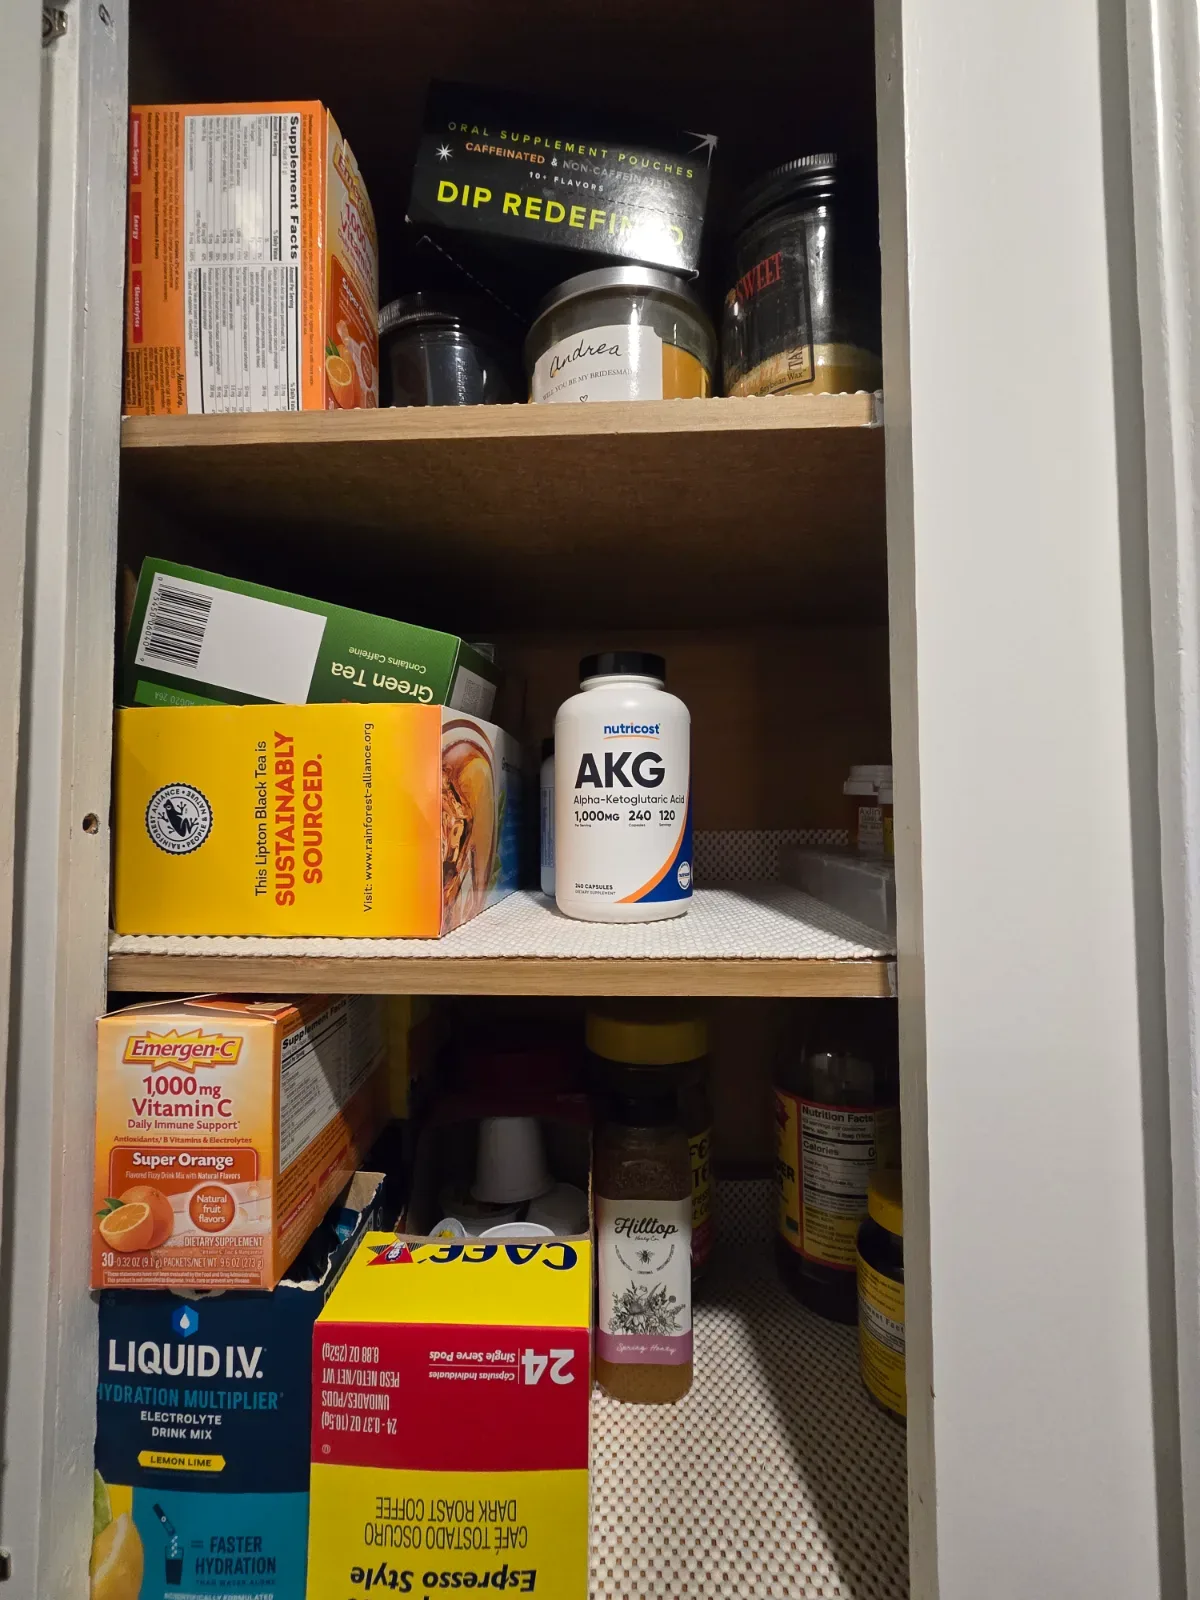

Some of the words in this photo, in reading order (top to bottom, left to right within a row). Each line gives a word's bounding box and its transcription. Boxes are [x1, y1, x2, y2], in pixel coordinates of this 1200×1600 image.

[448, 121, 489, 137] ORAL
[500, 130, 608, 159] SUPPLEMENT
[618, 153, 694, 179] POUCHES
[132, 148, 140, 177] Support
[288, 115, 299, 209] Supplement
[465, 142, 546, 164] CAFFEINATED
[551, 157, 558, 167] &
[563, 160, 672, 190] NON-CAFFEINATED
[529, 171, 547, 181] 10+
[553, 175, 604, 192] FLAVORS
[437, 180, 492, 209] DIP
[502, 192, 684, 246] REDEFIND
[132, 214, 140, 239] Energy
[289, 216, 299, 260] Facts
[735, 251, 782, 304] SWEET
[555, 381, 567, 392] YOU
[568, 377, 577, 386] BE
[578, 373, 589, 383] MY
[149, 591, 161, 617] 75450
[143, 620, 154, 647] 06040
[348, 646, 386, 663] Caffeine
[331, 662, 367, 687] Tea
[388, 657, 427, 674] Contains
[372, 673, 434, 703] Green
[603, 722, 659, 735] nutricost
[255, 741, 267, 752] is
[255, 755, 267, 778] Tea
[574, 751, 665, 789] AKG
[152, 789, 180, 813] ALLIANCE
[186, 791, 207, 814] NATURE
[255, 781, 267, 819] Black
[363, 723, 375, 880] www.rainforest-alliance.org
[573, 794, 668, 806] Alpha-Ketoglutaric
[669, 795, 685, 804] Acid
[274, 731, 295, 906] SUSTAINABLY
[303, 753, 323, 884] SOURCED.
[628, 810, 652, 821] 240
[659, 810, 676, 821] 120
[150, 816, 180, 849] RAINFOREST
[186, 824, 207, 847] PEOPLE
[255, 823, 271, 865] Lipton
[255, 868, 267, 896] This
[363, 884, 372, 913] Visit:
[282, 1012, 329, 1050] Supplement
[131, 1040, 236, 1062] Emergen-C
[142, 1075, 197, 1098] 1,000
[199, 1084, 222, 1099] mg
[132, 1097, 214, 1118] Vitamin
[217, 1098, 233, 1118] C
[802, 1105, 844, 1122] Nutrition
[847, 1113, 873, 1123] Facts
[127, 1119, 152, 1132] Daily
[154, 1120, 195, 1130] Immune
[170, 1136, 201, 1144] Vitamins
[202, 1136, 209, 1144] &
[209, 1137, 252, 1145] Electrolytes
[803, 1141, 839, 1156] Calories
[132, 1152, 176, 1167] Super
[178, 1153, 234, 1170] Orange
[125, 1171, 147, 1179] Flavored
[148, 1171, 161, 1180] Fizzy
[185, 1172, 197, 1180] with
[197, 1172, 219, 1180] Natural
[219, 1172, 241, 1180] Flavors
[196, 1194, 227, 1203] Natural
[198, 1214, 226, 1223] flavors
[202, 1205, 221, 1214] fruit
[614, 1217, 679, 1239] Hilltop
[184, 1236, 214, 1247] DIETARY
[215, 1236, 264, 1247] SUPPLEMENT
[101, 1252, 114, 1267] 30
[132, 1257, 140, 1267] OZ
[231, 1258, 240, 1267] OZ
[108, 1339, 220, 1377] LIQUID
[225, 1346, 264, 1379] I.V.
[322, 1343, 347, 1362] (252g)
[349, 1346, 360, 1362] OZ
[429, 1351, 454, 1361] Pods
[456, 1352, 484, 1362] Serve
[486, 1350, 515, 1363] Single
[616, 1342, 647, 1354] Spring
[650, 1342, 677, 1355] Honey
[322, 1368, 335, 1385] WT
[429, 1371, 477, 1380] Individuales
[479, 1371, 515, 1380] Cápsulas
[521, 1348, 575, 1386] 24
[336, 1369, 377, 1387] NETO/NET
[380, 1371, 400, 1388] PESO
[96, 1382, 179, 1408] HYDRATION
[184, 1389, 278, 1410] MULTIPLIER
[322, 1390, 390, 1410] UNIDADES/PODS
[140, 1410, 222, 1425] ELECTROLYTE
[321, 1411, 348, 1431] (10.5g)
[350, 1415, 361, 1432] OZ
[363, 1417, 380, 1434] 0.37
[387, 1418, 397, 1434] 24
[151, 1426, 186, 1439] DRINK
[190, 1428, 213, 1440] MIX
[150, 1456, 185, 1466] LEMON
[187, 1457, 212, 1467] LIME
[376, 1496, 424, 1521] COFFEE
[428, 1499, 474, 1522] ROAST
[478, 1499, 517, 1522] DARK
[210, 1535, 263, 1553] FASTER
[364, 1522, 422, 1549] OSCURO
[425, 1526, 491, 1550] TOSTADO
[494, 1526, 528, 1555] CAFÉ
[195, 1556, 276, 1576] HYDRATION
[350, 1562, 414, 1593] Style
[422, 1564, 537, 1592] Espresso
